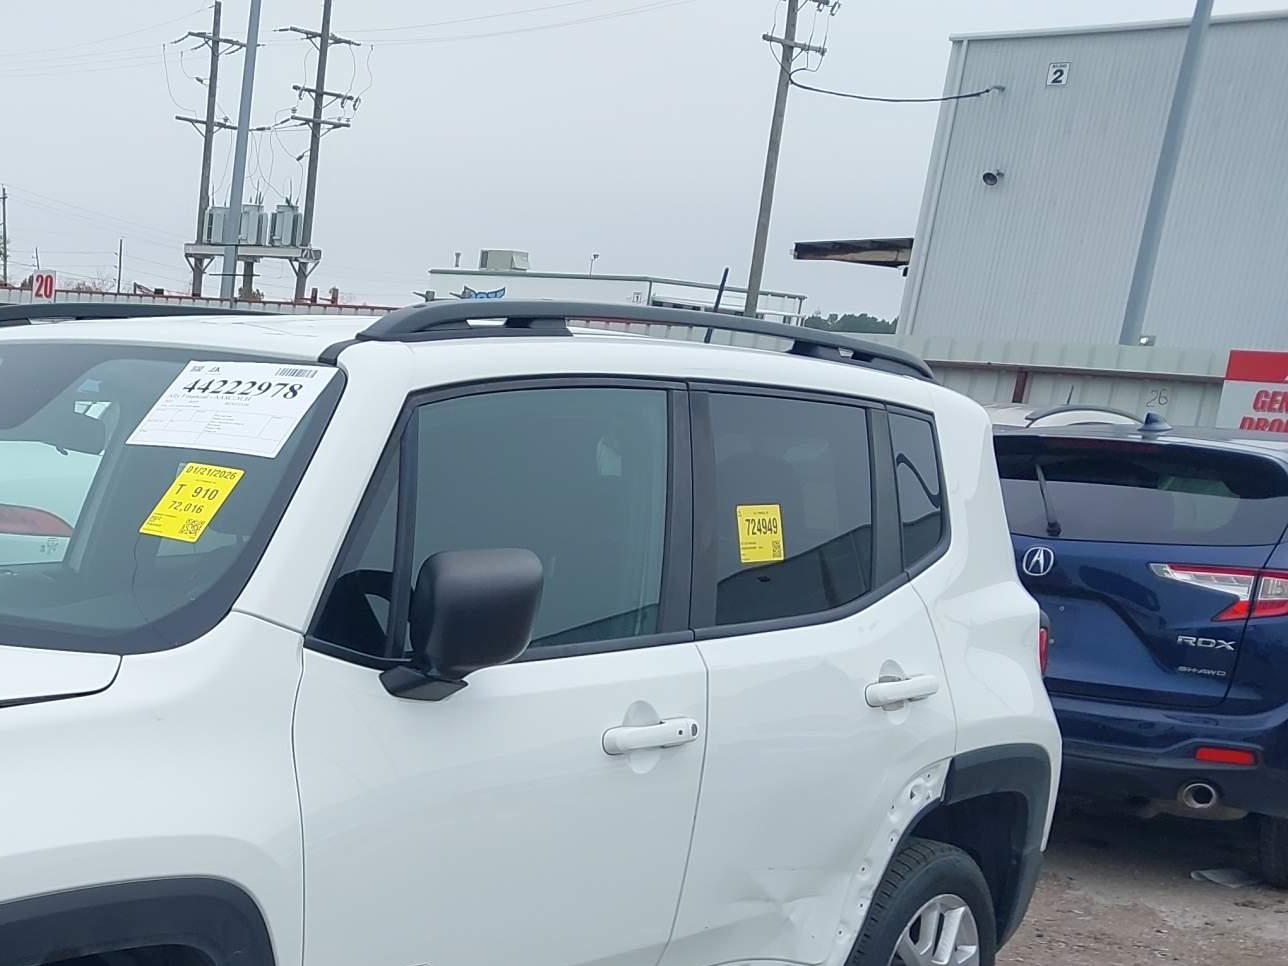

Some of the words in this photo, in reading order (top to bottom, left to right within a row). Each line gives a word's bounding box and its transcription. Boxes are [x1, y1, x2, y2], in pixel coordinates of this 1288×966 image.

[1052, 69, 1065, 84] 2
[35, 274, 54, 299] 20
[183, 377, 303, 400] 44222978
[1146, 388, 1169, 408] 26
[1239, 416, 1288, 434] DRO
[186, 465, 237, 480] 01/21/2026
[175, 484, 187, 495] T
[192, 486, 219, 501] 910
[168, 500, 204, 514] 72,016
[745, 517, 778, 536] 724949
[1177, 635, 1236, 651] RDX
[1177, 666, 1227, 676] SH-AWD
